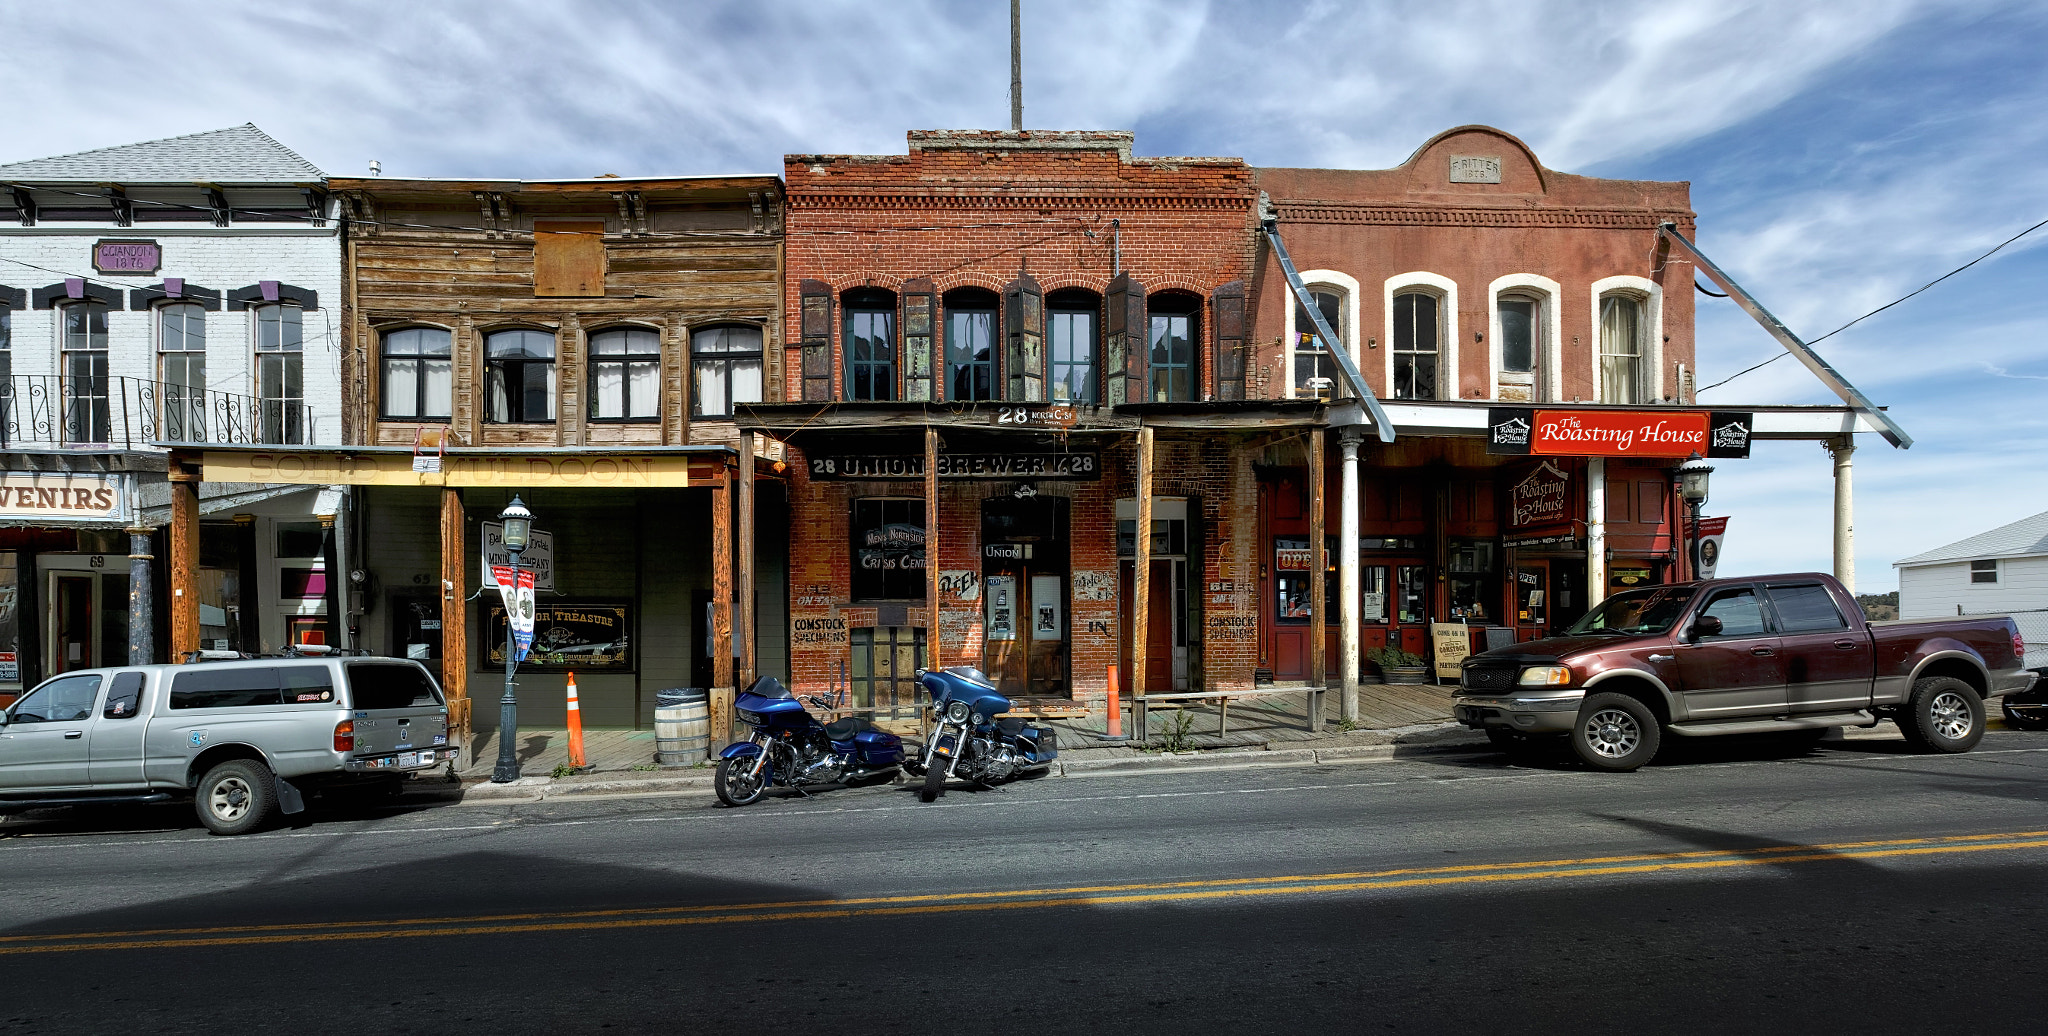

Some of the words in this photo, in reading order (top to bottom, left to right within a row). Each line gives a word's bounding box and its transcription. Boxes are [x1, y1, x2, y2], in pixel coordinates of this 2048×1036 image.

[998, 406, 1028, 424] 28
[1560, 416, 1581, 428] The
[1508, 433, 1528, 442] House
[1541, 423, 1634, 450] Roasting
[1640, 421, 1703, 443] House
[250, 455, 379, 482] SOLID
[813, 459, 836, 474] 28
[842, 458, 925, 476] UNION
[1071, 456, 1093, 472] 28
[1520, 480, 1565, 499] Roasting
[1532, 495, 1564, 513] House
[890, 528, 926, 544] NORTHSIDE
[488, 552, 510, 566] MININ
[986, 546, 1019, 558] UNION
[90, 556, 104, 568] 69
[861, 554, 896, 569] CRISIS
[1519, 573, 1537, 584] OPEN
[554, 610, 613, 627] TREASURE
[795, 618, 846, 630] COMSTOCK
[1210, 617, 1255, 627] COMSTOCK
[1089, 621, 1111, 637] IN
[795, 631, 846, 643] SPECIMENS
